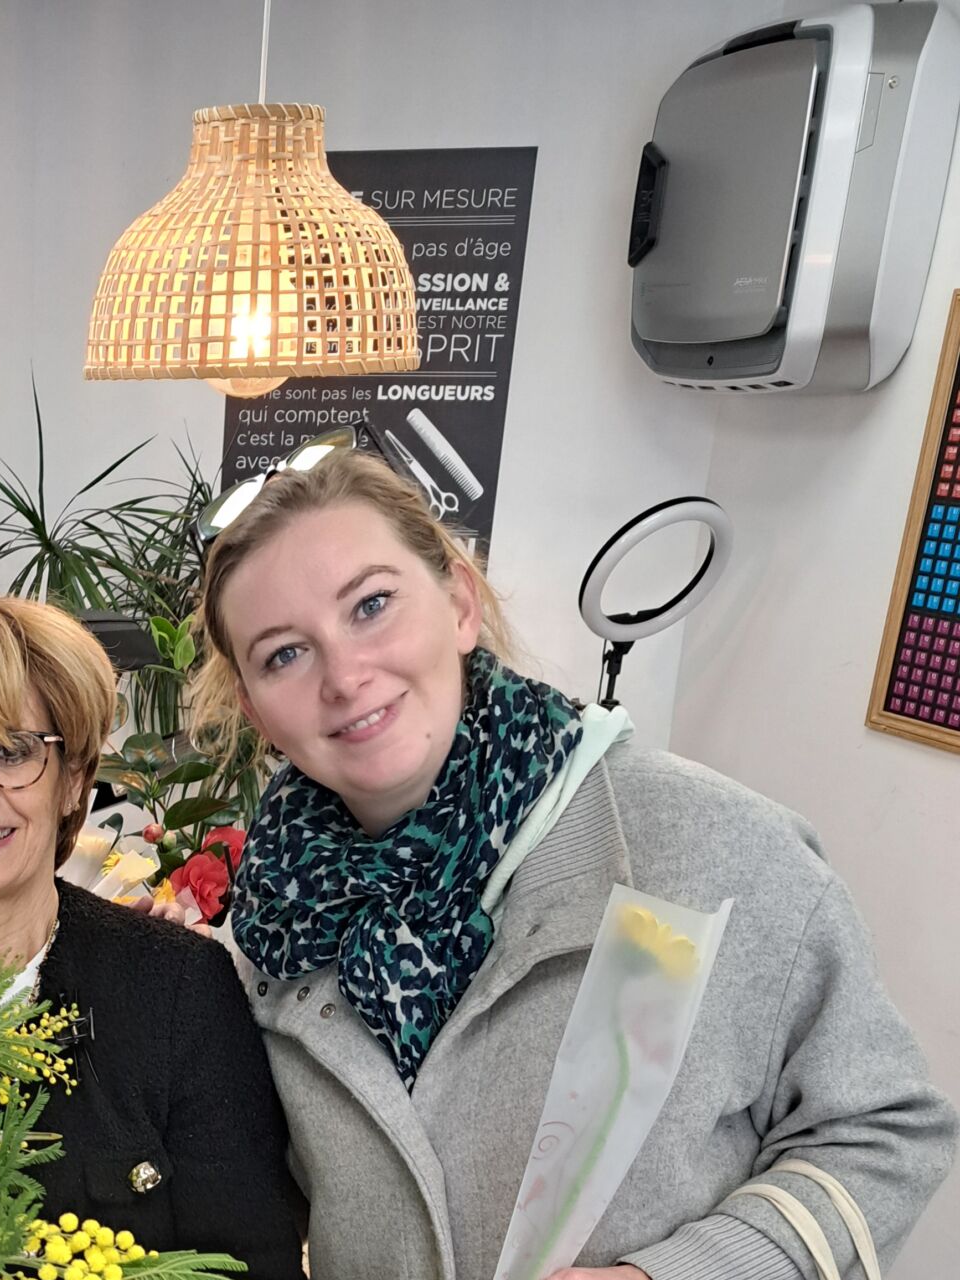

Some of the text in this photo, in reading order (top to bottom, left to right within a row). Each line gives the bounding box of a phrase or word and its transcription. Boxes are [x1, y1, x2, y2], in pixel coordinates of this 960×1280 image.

[370, 189, 416, 210] SUR
[422, 187, 518, 209] MESURE
[411, 237, 512, 261] pas d'âge
[414, 272, 511, 293] SSION &
[417, 315, 508, 329] EST NOTRE
[285, 386, 317, 400] sont
[321, 389, 347, 402] pas
[352, 386, 372, 400] les
[376, 384, 496, 401] LONGUEURS
[238, 405, 370, 427] qui comptent
[236, 430, 276, 447] c'est
[280, 430, 295, 446] la
